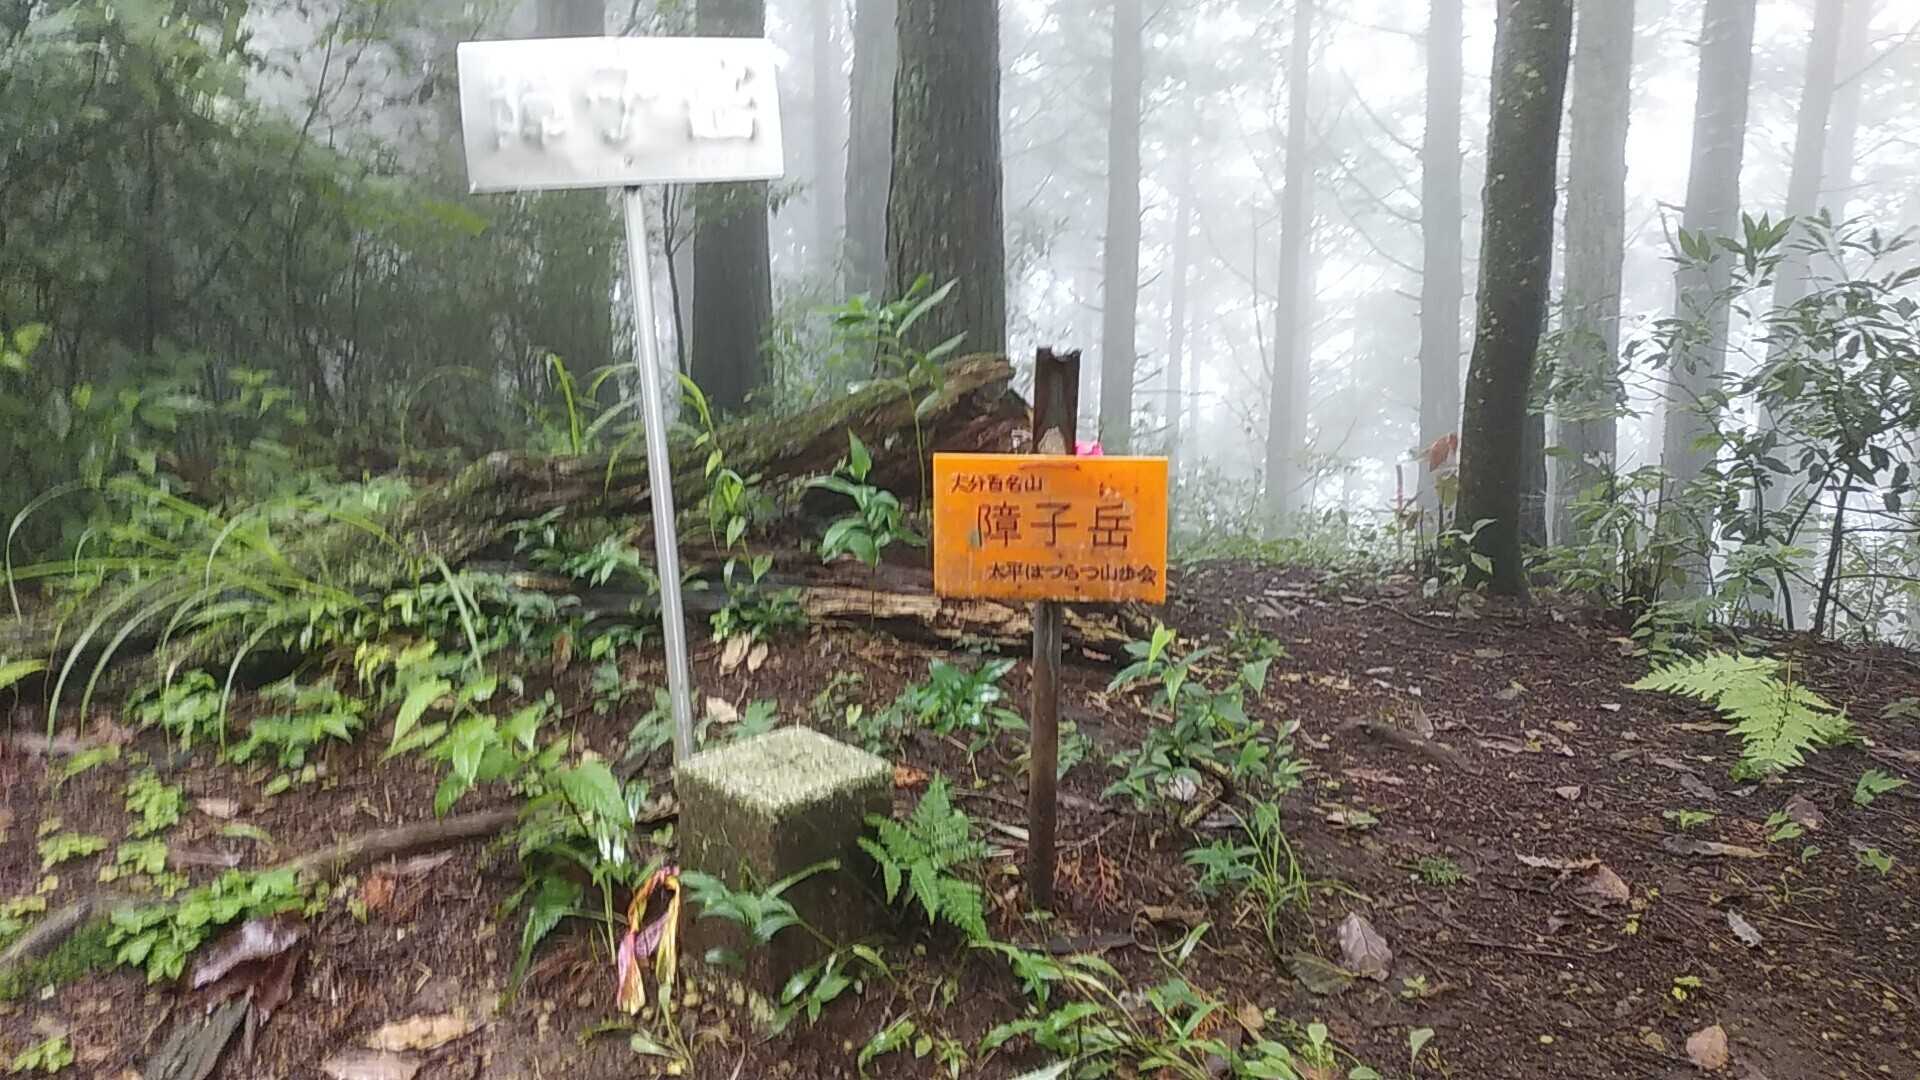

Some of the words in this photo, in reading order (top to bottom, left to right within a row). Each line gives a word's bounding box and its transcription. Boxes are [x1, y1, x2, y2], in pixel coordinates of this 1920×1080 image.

[951, 473, 1043, 493] 大分百名山
[976, 500, 1133, 548] 障子岳
